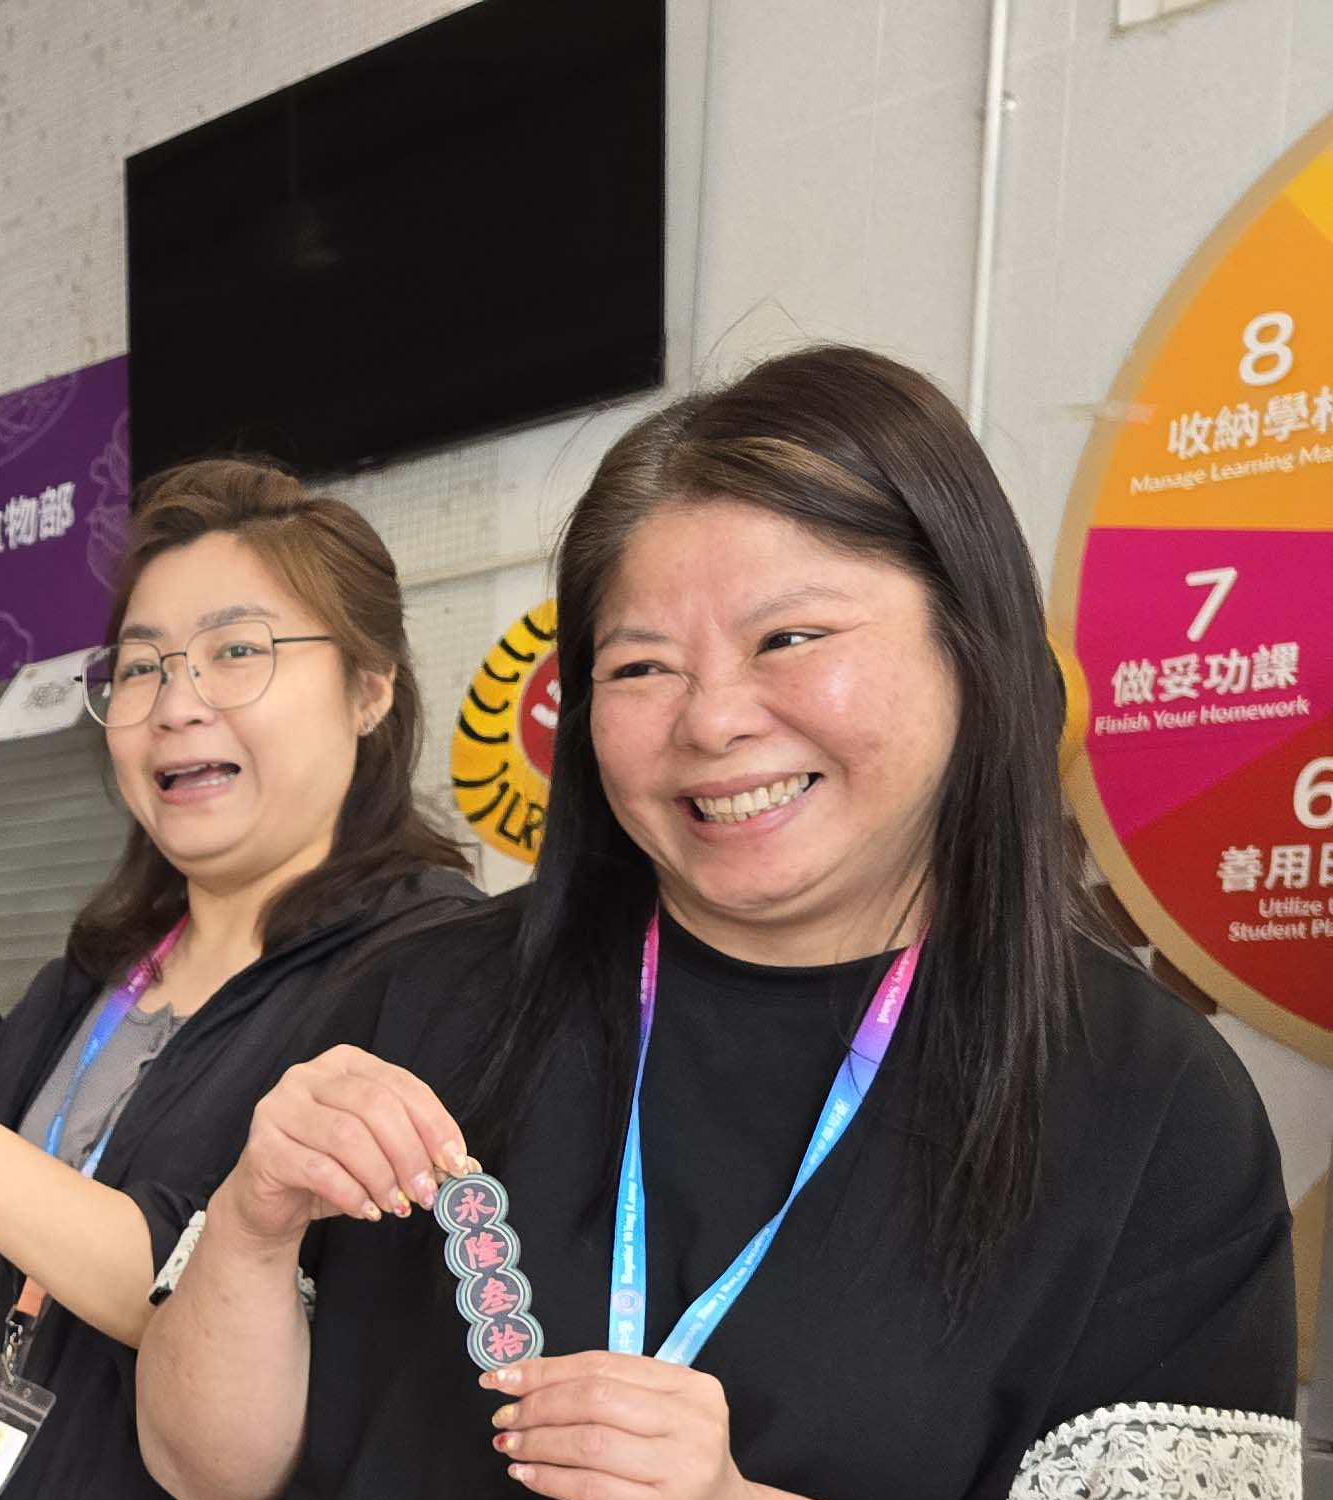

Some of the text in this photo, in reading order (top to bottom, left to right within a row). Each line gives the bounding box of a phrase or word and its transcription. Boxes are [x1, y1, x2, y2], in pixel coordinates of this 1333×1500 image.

[1238, 311, 1295, 386] 8
[1130, 468, 1206, 496] Manage
[1210, 451, 1294, 482] Learning
[1185, 566, 1238, 642] 7
[1111, 641, 1300, 708] 做妥功課
[1094, 694, 1311, 736] Finish Your Homework
[1293, 756, 1333, 829] 6
[1228, 920, 1307, 942] Student
[1258, 897, 1324, 918] Utilize
